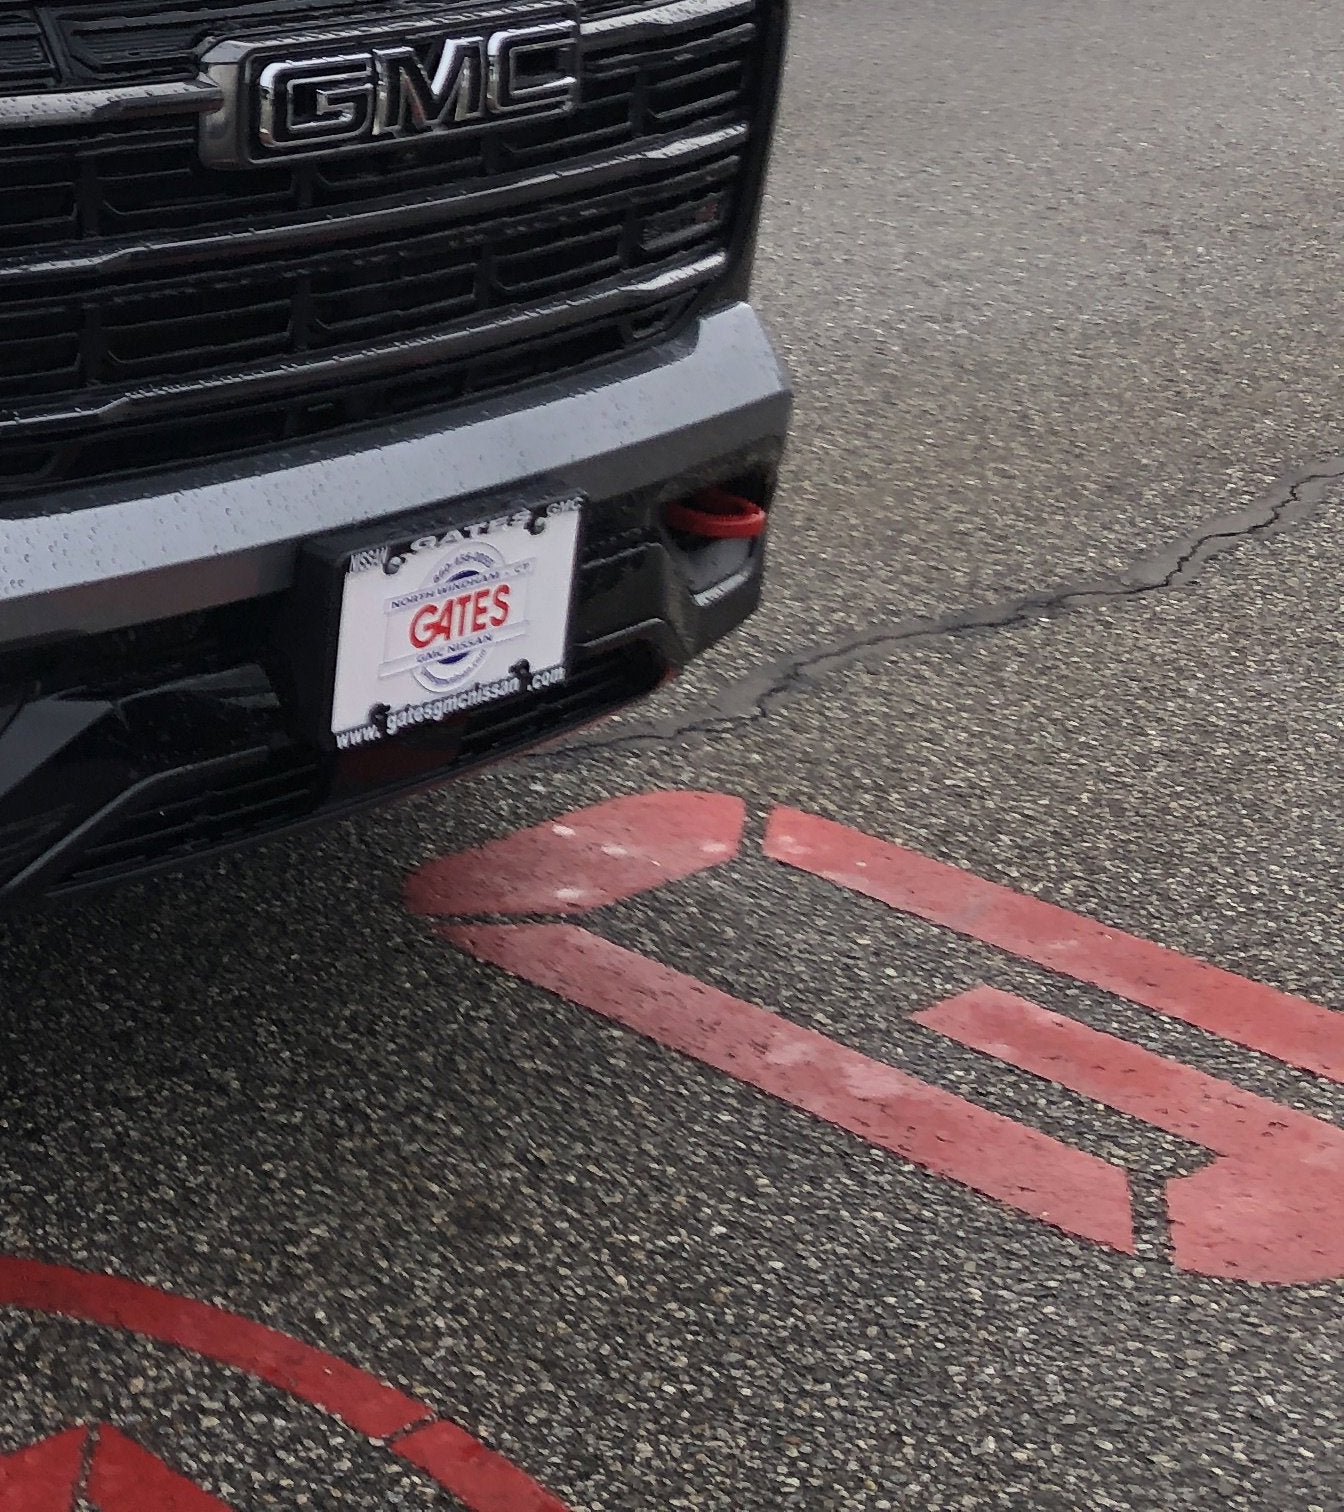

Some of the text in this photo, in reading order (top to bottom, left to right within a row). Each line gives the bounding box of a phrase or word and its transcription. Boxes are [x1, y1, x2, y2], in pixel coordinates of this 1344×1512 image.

[258, 19, 578, 149] GMC
[410, 508, 531, 553] GATES
[547, 497, 584, 517] GMC
[391, 590, 435, 608] NORTH
[437, 572, 500, 595] WINDHAM
[409, 583, 512, 649] GATES
[447, 634, 493, 653] NISSAN
[386, 676, 520, 735] gatesgmcnissan
